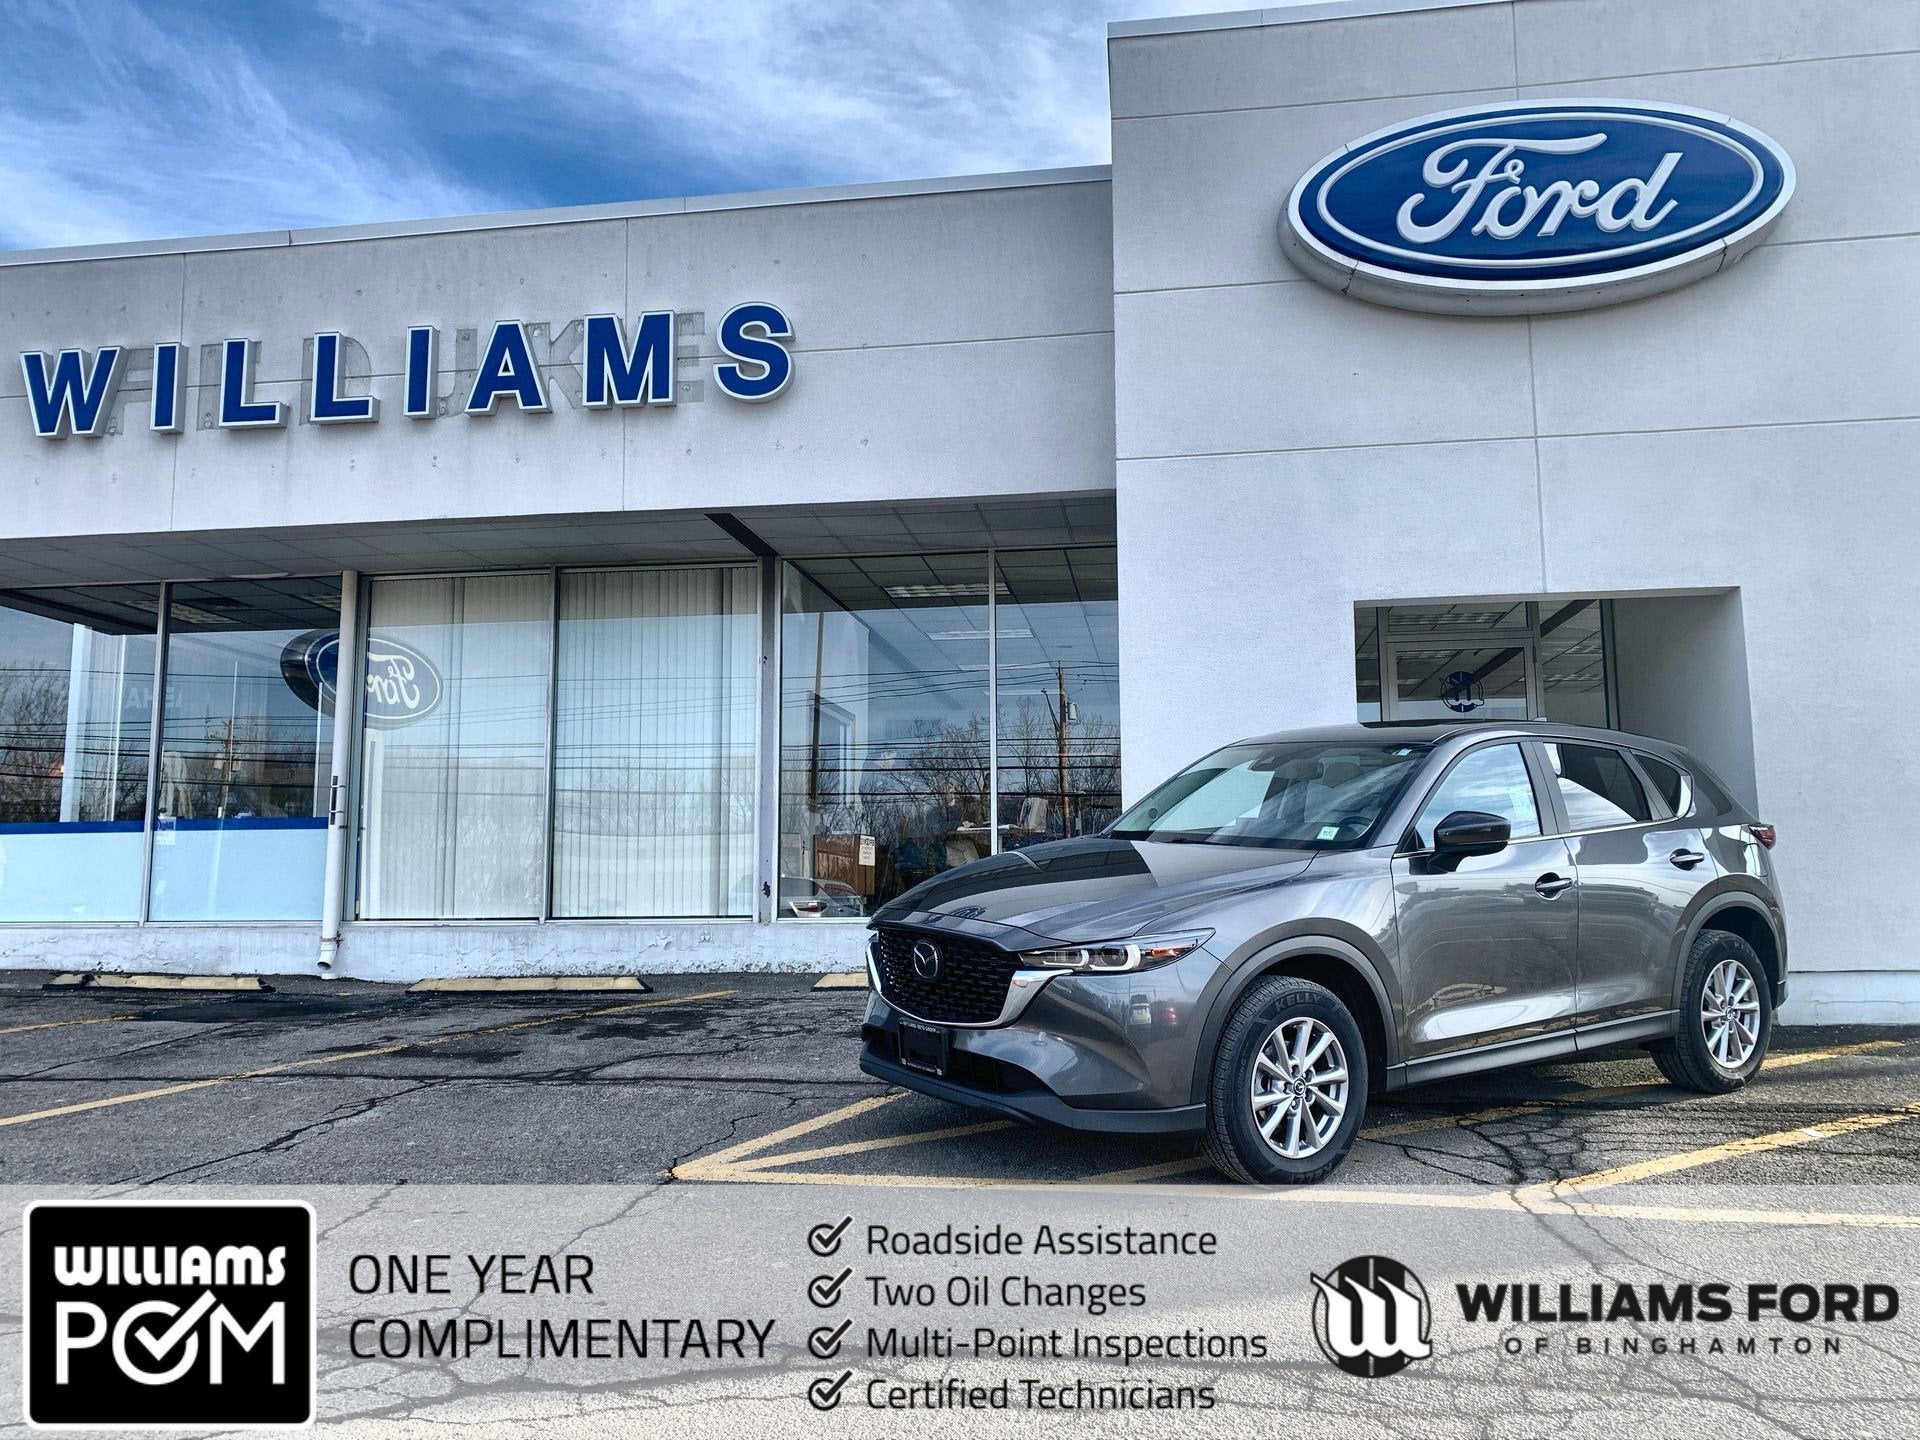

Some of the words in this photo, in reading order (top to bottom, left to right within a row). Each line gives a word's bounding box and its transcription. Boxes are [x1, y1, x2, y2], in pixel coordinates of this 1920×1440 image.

[1396, 132, 1683, 244] Ford
[19, 302, 796, 439] WILLIAMS
[1275, 992, 1322, 1012] KELLY
